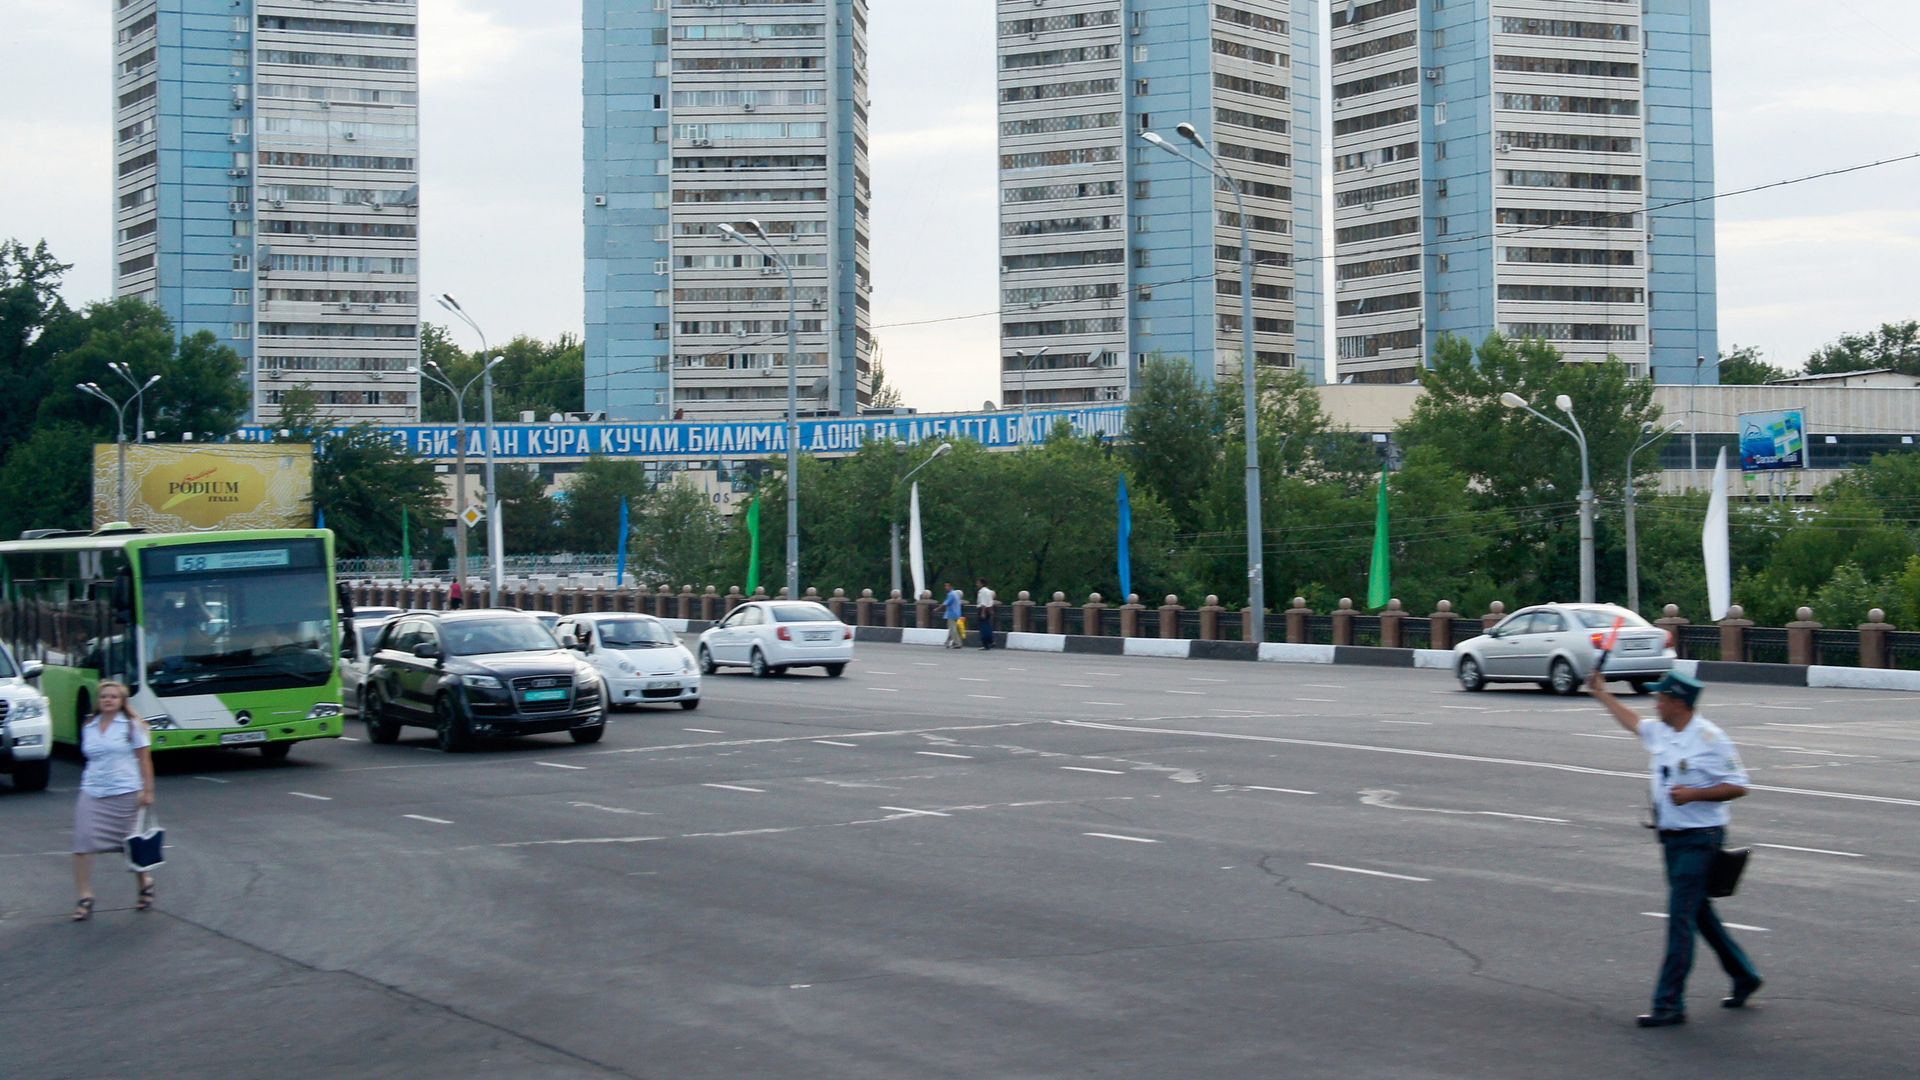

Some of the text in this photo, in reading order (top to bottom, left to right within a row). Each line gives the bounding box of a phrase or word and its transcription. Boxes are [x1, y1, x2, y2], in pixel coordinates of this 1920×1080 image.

[1007, 414, 1058, 442] БАХТЛ
[168, 481, 240, 495] PODIUM
[182, 556, 207, 571] 58
